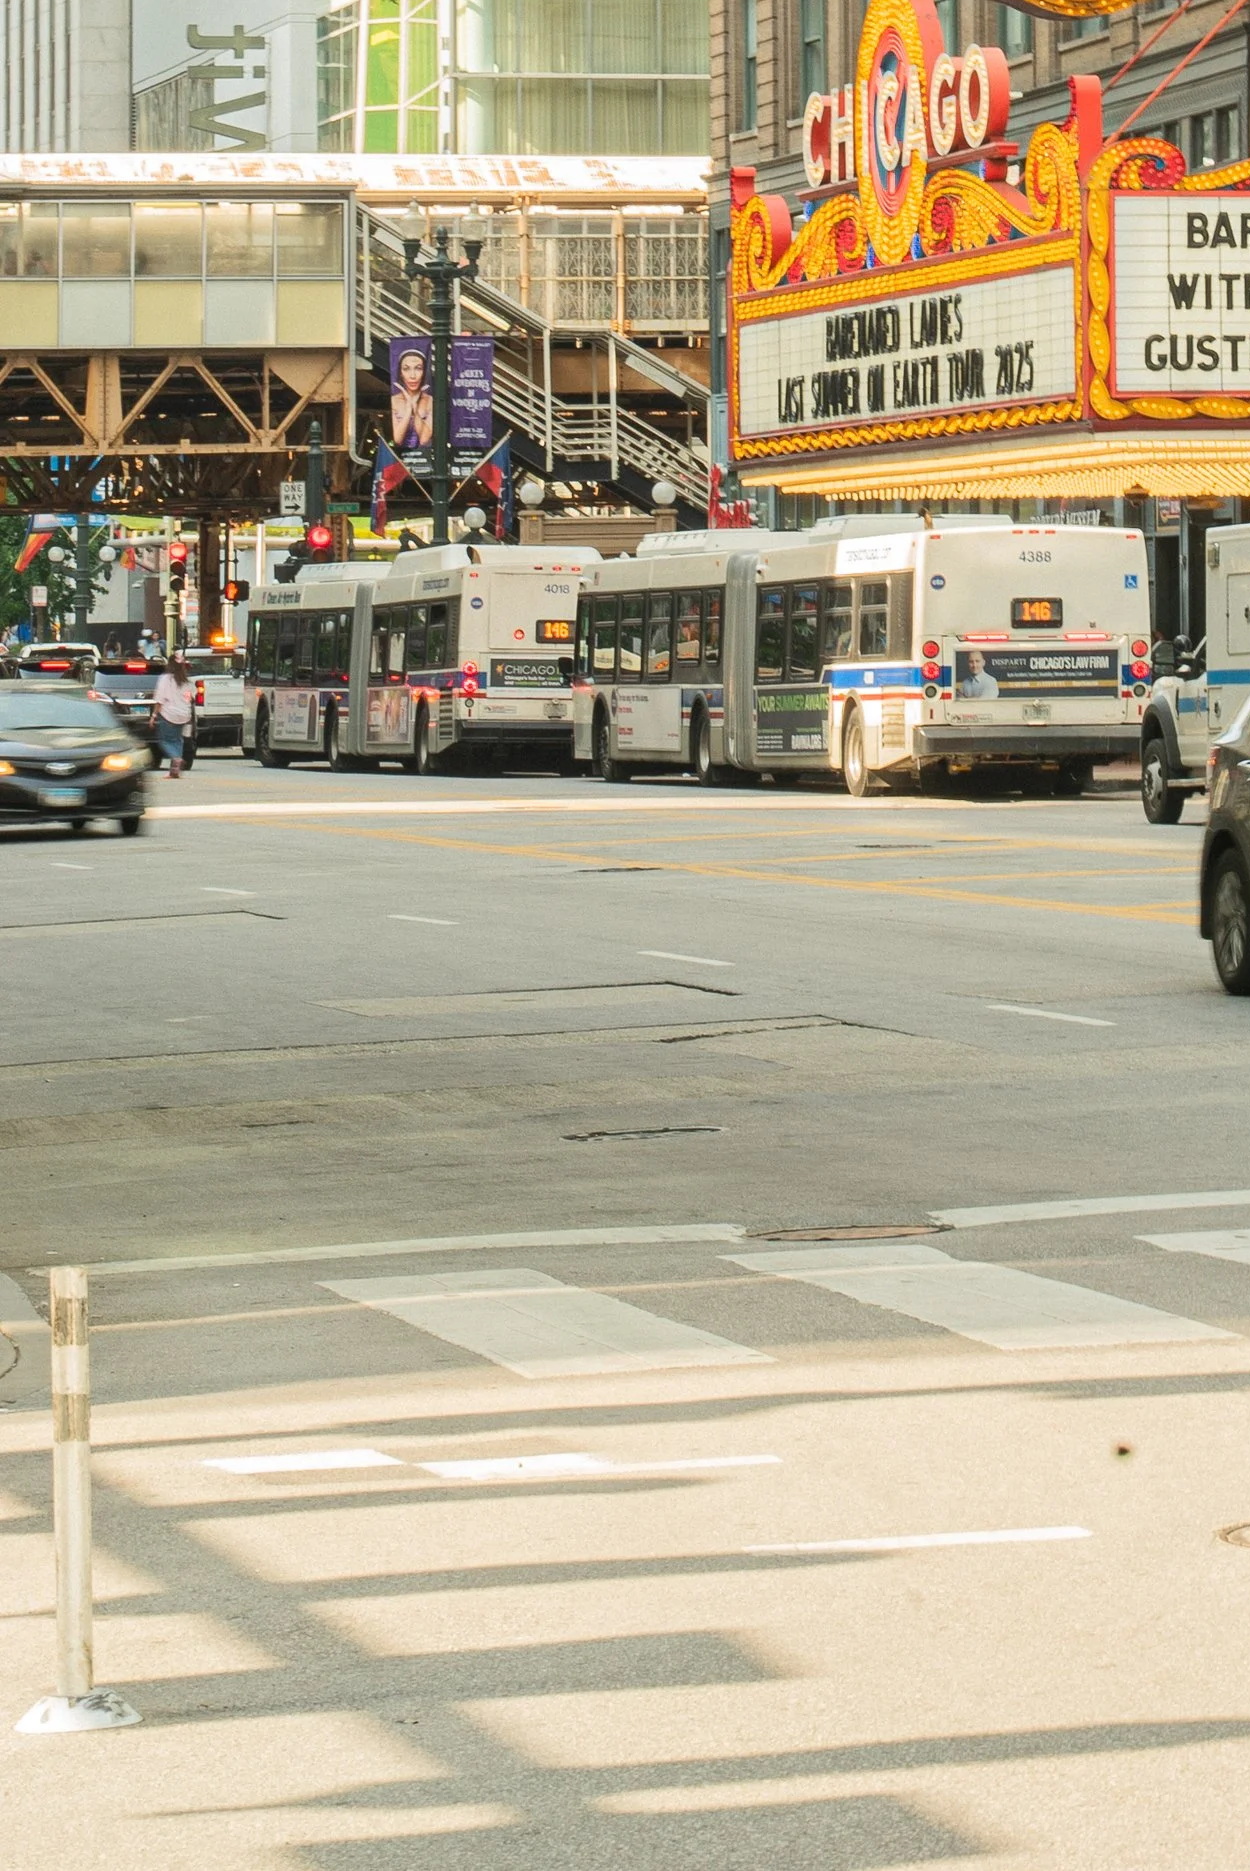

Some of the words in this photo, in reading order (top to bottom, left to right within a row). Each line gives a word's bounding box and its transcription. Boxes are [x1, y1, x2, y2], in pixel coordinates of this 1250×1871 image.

[802, 43, 990, 188] CHICAGO
[910, 293, 962, 350] LADIES
[777, 376, 805, 423] LAST
[811, 364, 861, 417] SUMMER
[893, 355, 939, 409] EARTH
[947, 347, 985, 401] TOUR
[995, 340, 1035, 395] 2025
[284, 484, 303, 493] ONE
[284, 494, 303, 502] WAY
[1018, 550, 1052, 564] 4388
[544, 583, 570, 595] 4018
[1021, 601, 1051, 622] 146
[544, 622, 569, 639] 146
[504, 665, 556, 675] CHICAGO
[991, 657, 1027, 666] DISPARTI
[1030, 655, 1070, 670] CHICAGO'S
[1071, 655, 1090, 669] LAW
[1090, 655, 1110, 669] FIRM
[758, 696, 775, 712] YOUR
